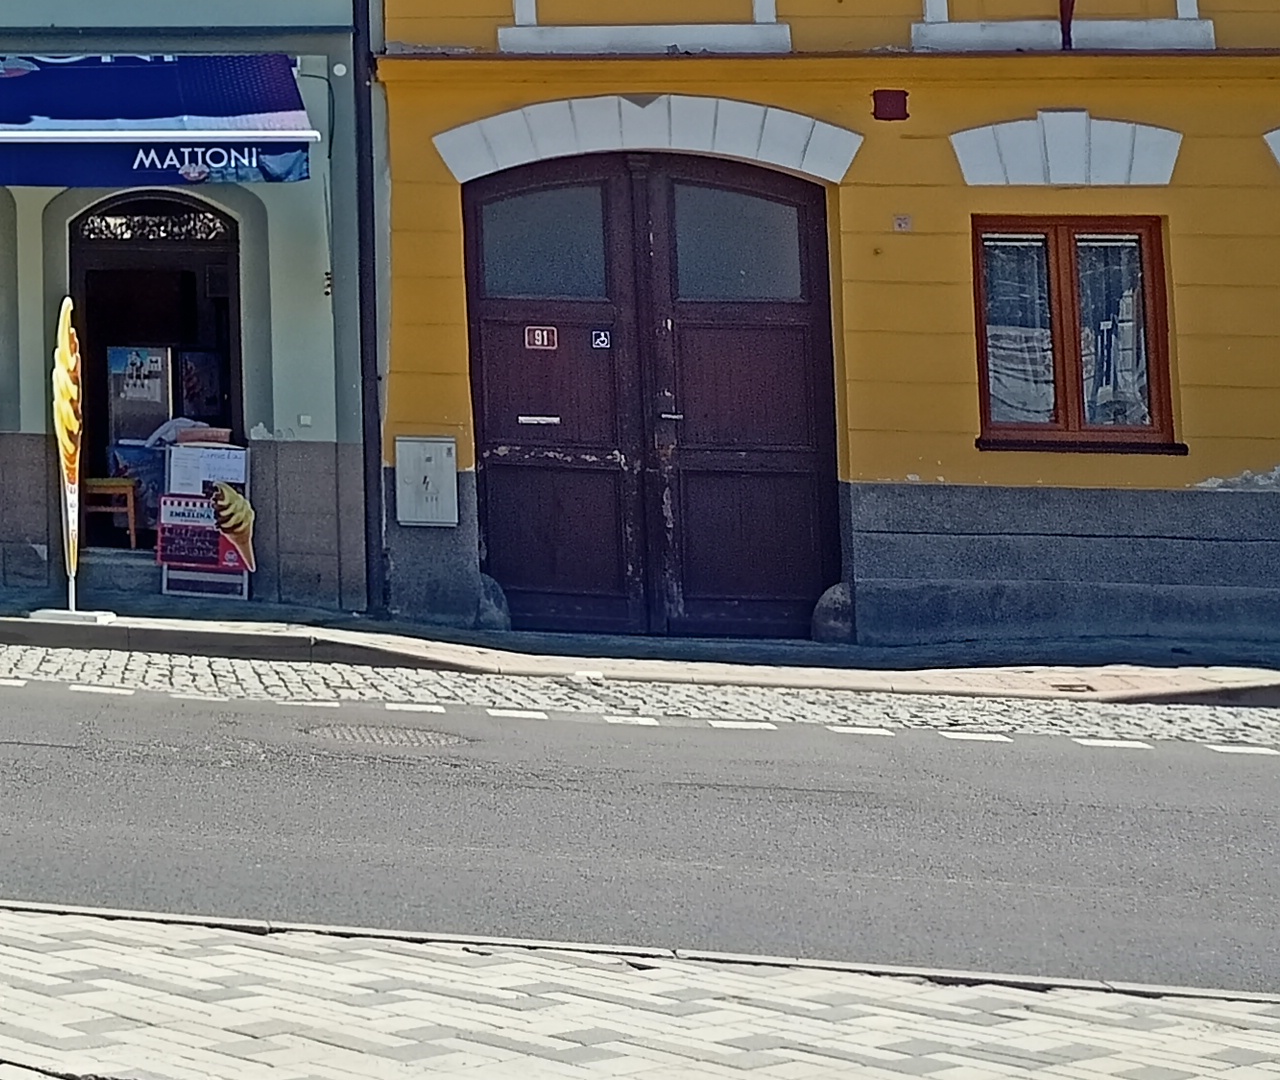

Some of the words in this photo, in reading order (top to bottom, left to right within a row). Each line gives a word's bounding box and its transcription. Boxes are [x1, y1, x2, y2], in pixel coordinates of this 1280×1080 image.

[133, 147, 258, 170] MATTONI
[534, 329, 548, 346] 91
[169, 510, 212, 519] ZMRZLINA
